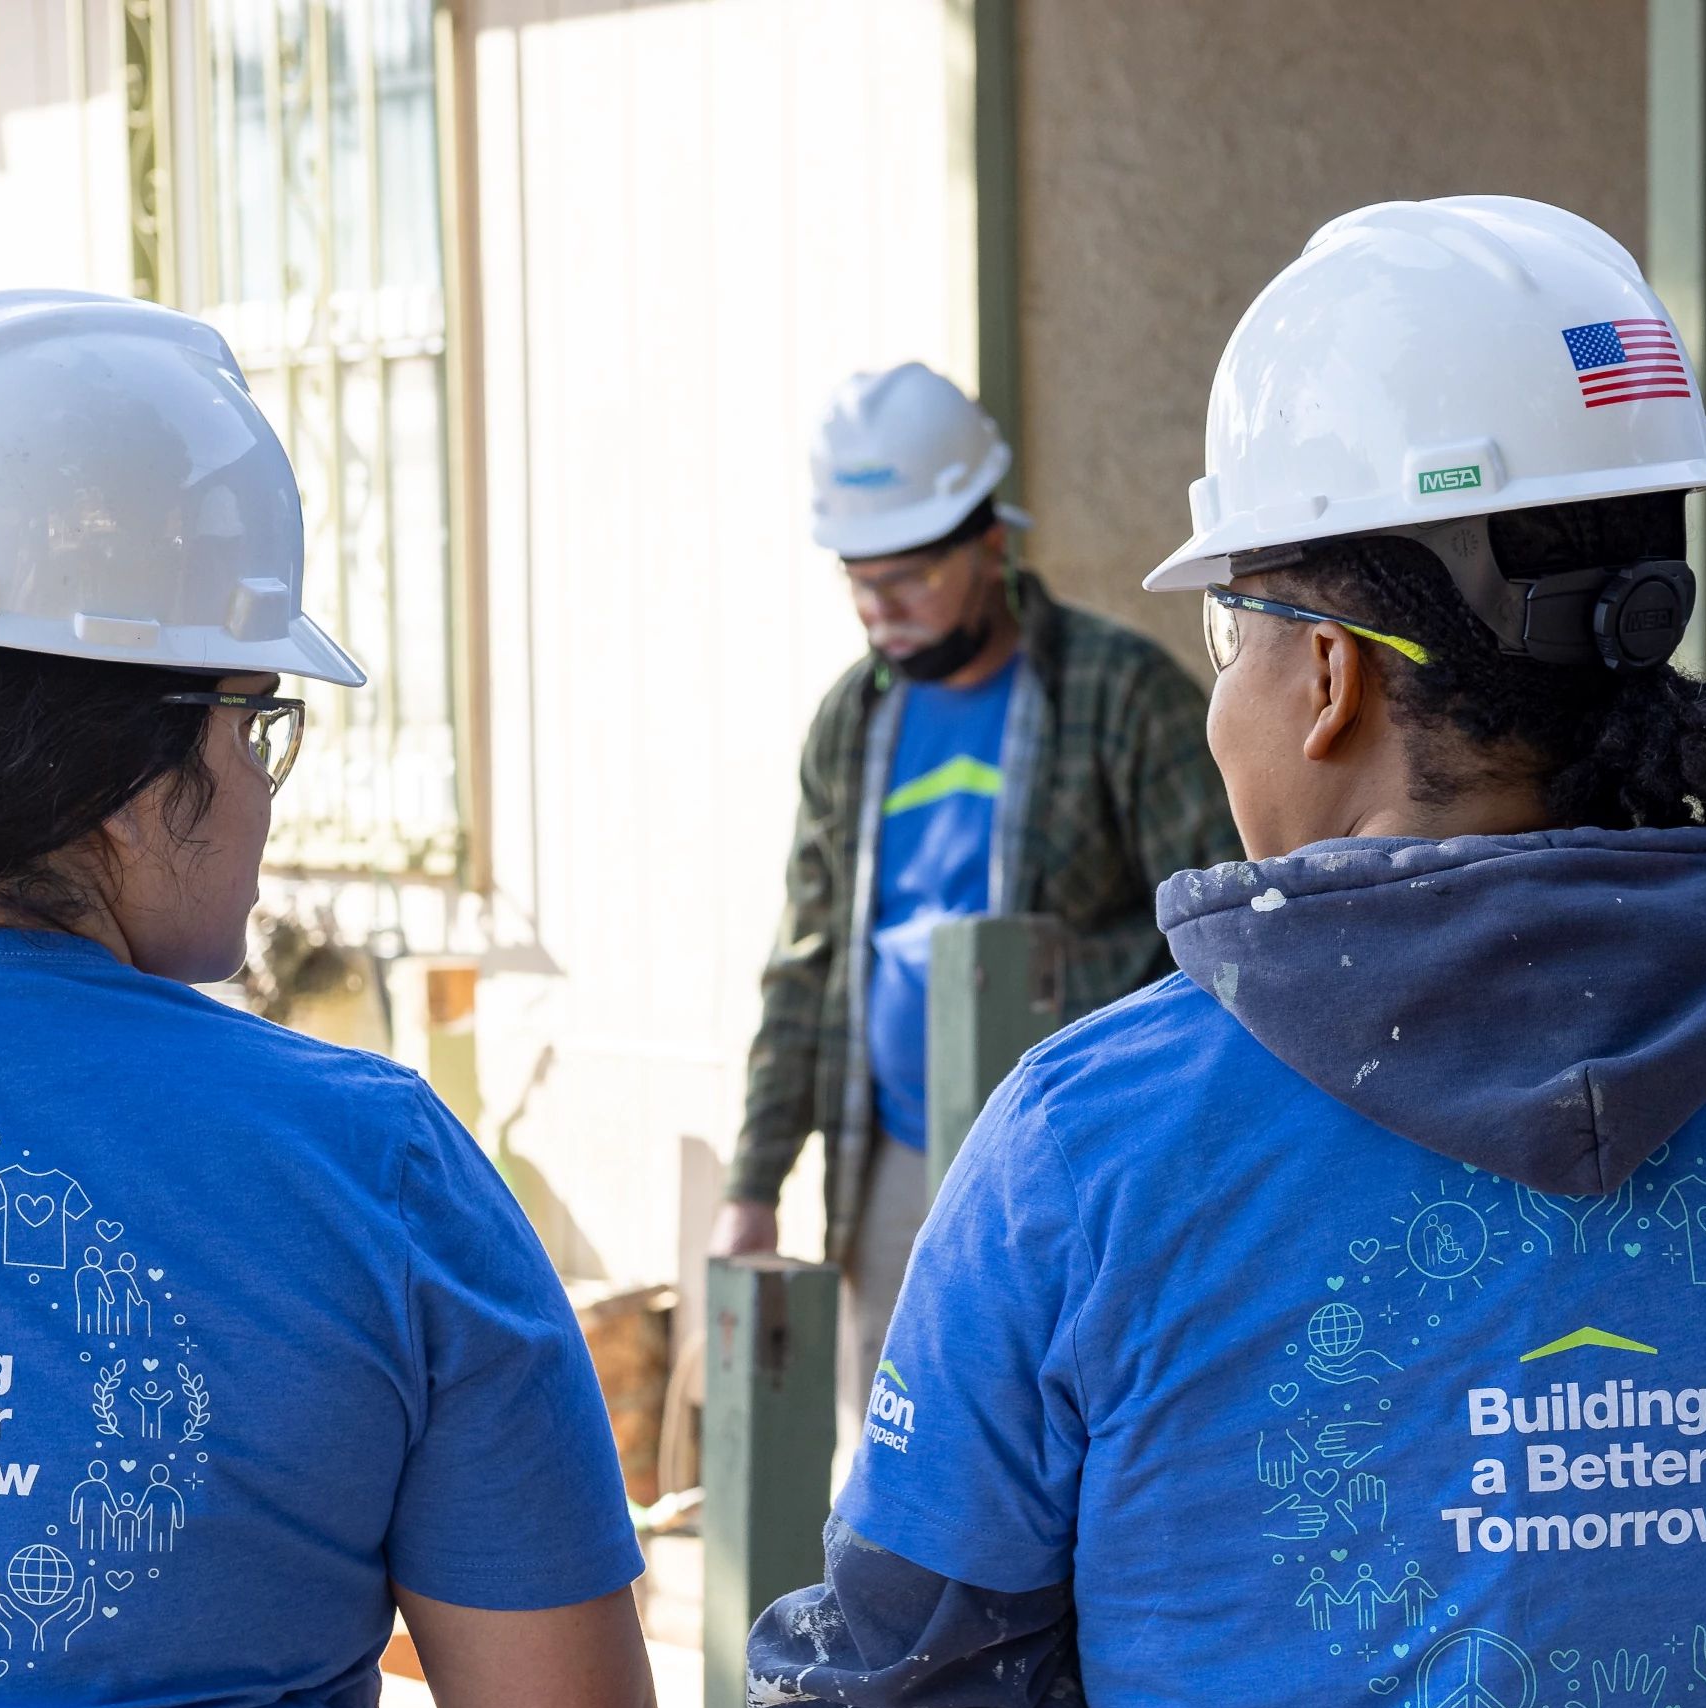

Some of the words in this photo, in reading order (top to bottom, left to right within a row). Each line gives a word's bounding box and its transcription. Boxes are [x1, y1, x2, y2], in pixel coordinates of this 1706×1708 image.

[1422, 468, 1479, 491] MSA
[1627, 610, 1670, 631] MSA
[870, 1377, 913, 1431] ton
[868, 1422, 909, 1454] mpact
[1470, 1458, 1508, 1496] a
